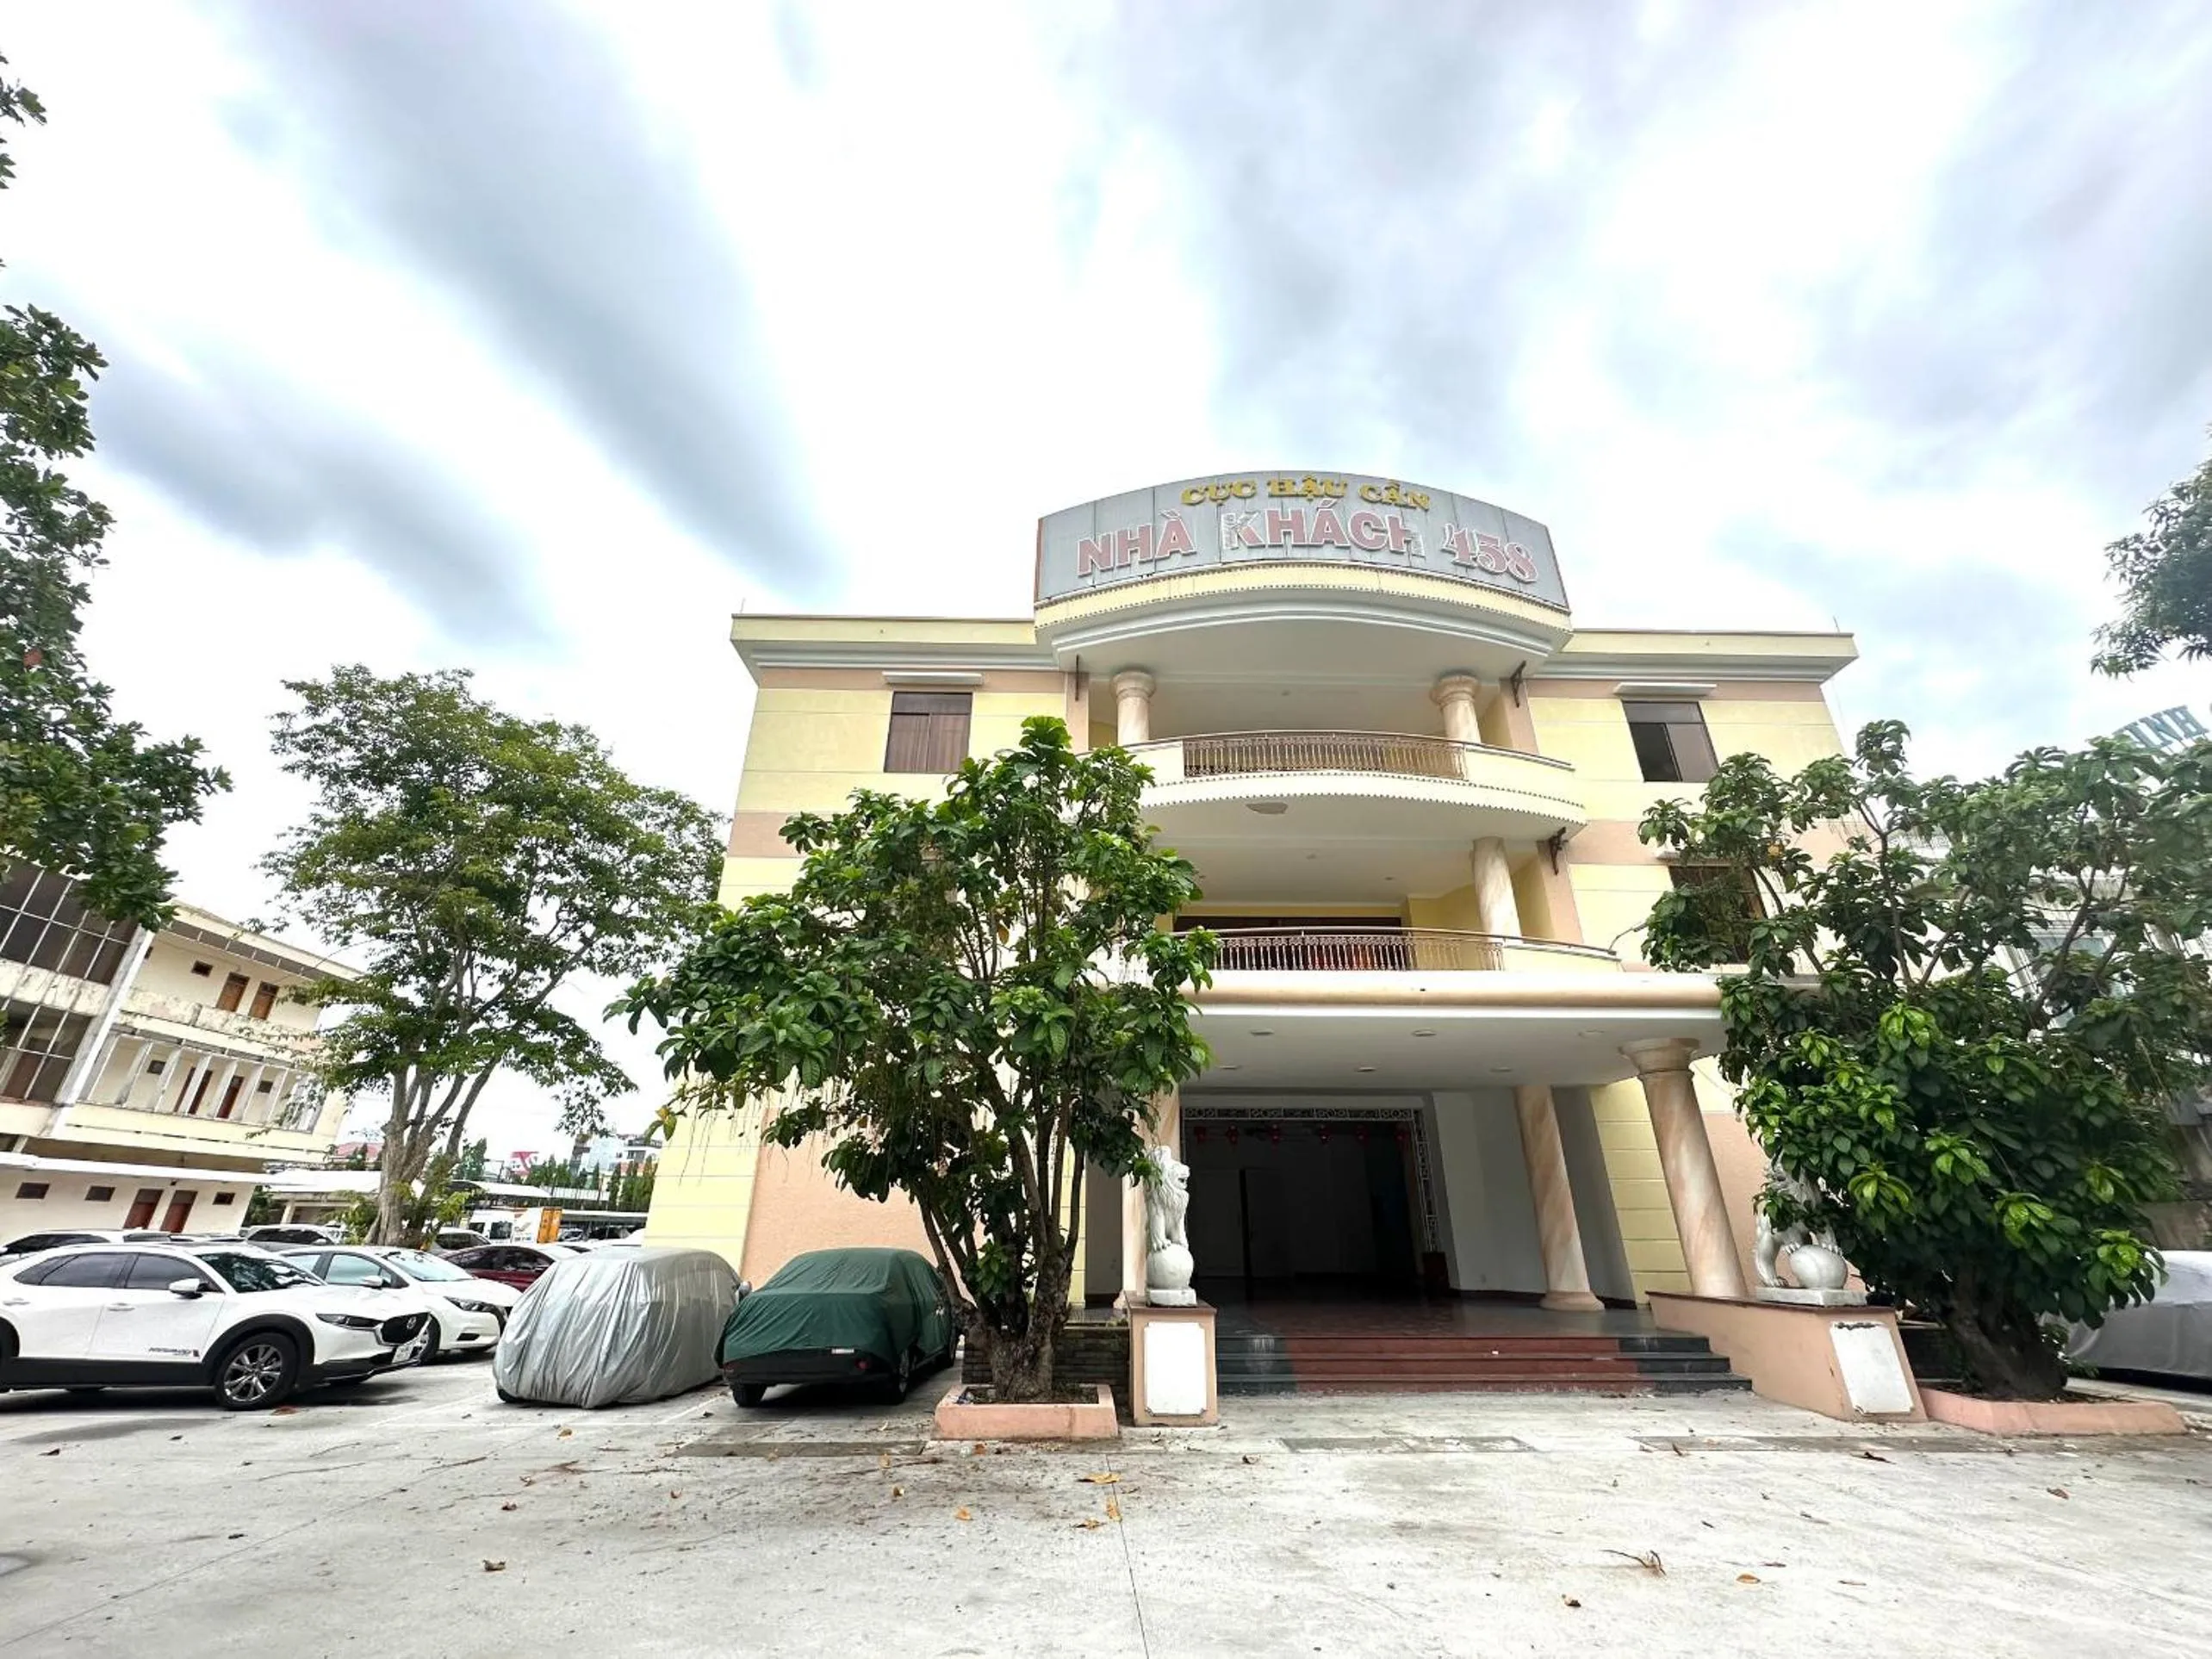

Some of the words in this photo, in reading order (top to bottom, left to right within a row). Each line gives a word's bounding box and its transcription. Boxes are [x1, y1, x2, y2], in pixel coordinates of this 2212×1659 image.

[1179, 479, 1257, 506] CỤC
[1077, 509, 1197, 578] NHÀ
[1220, 497, 1426, 560] KHÁCH
[1440, 523, 1538, 585] 458
